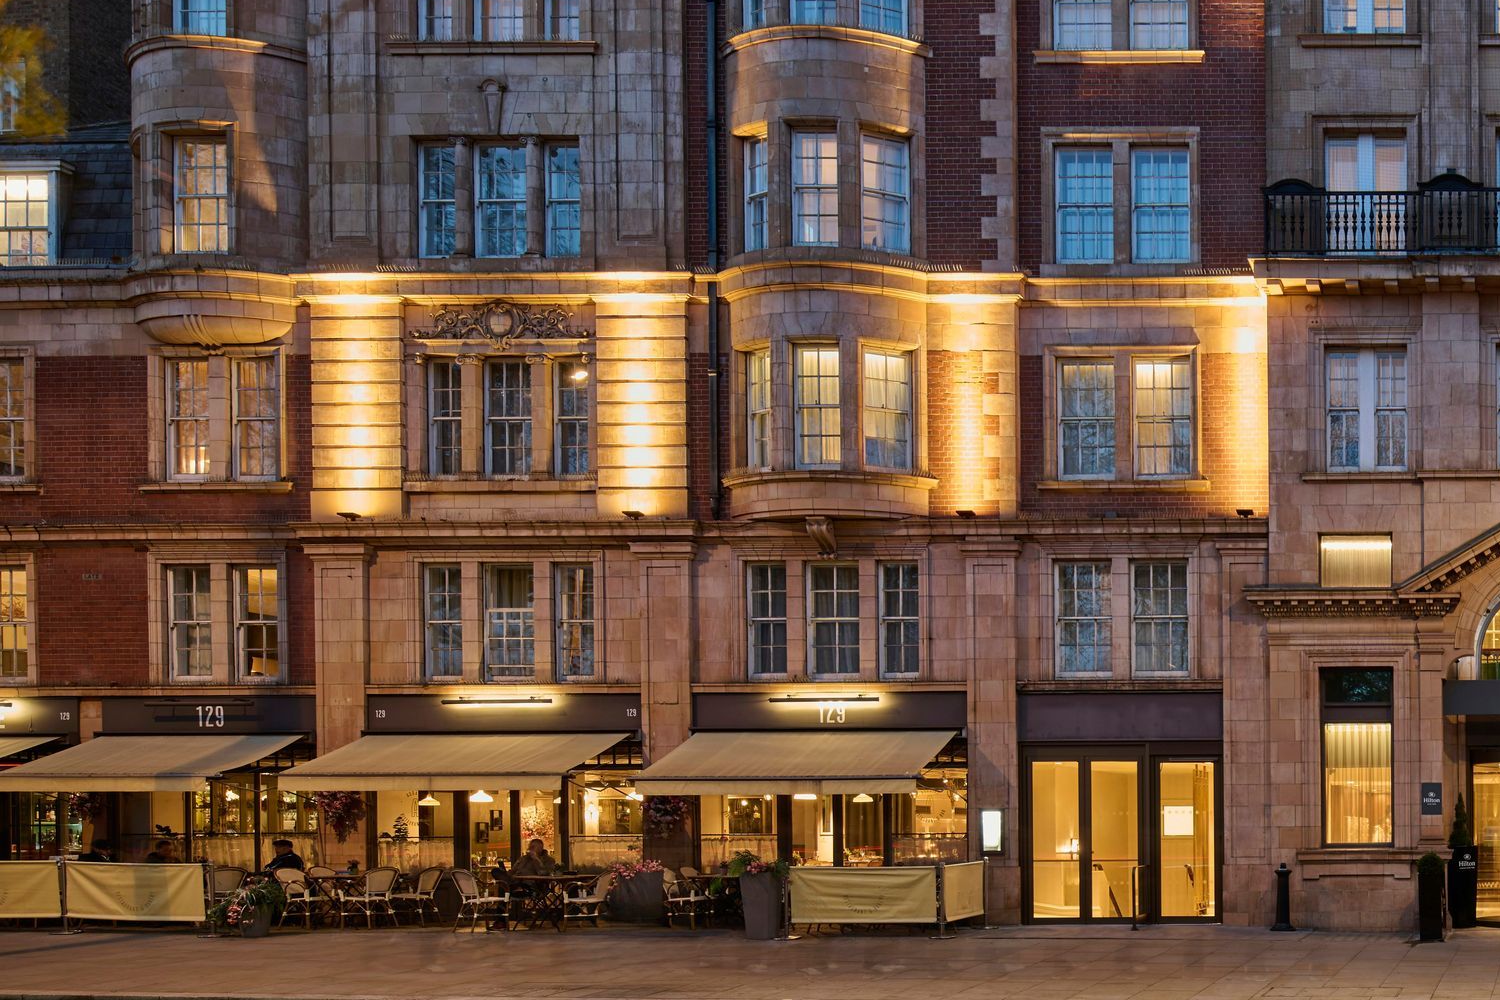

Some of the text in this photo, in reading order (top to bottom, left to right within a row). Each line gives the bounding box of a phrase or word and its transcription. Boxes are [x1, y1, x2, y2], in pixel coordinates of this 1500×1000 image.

[60, 712, 70, 720] 129
[195, 705, 225, 728] 129
[375, 709, 386, 718] 129
[626, 708, 637, 717] 129
[818, 700, 846, 724] 129
